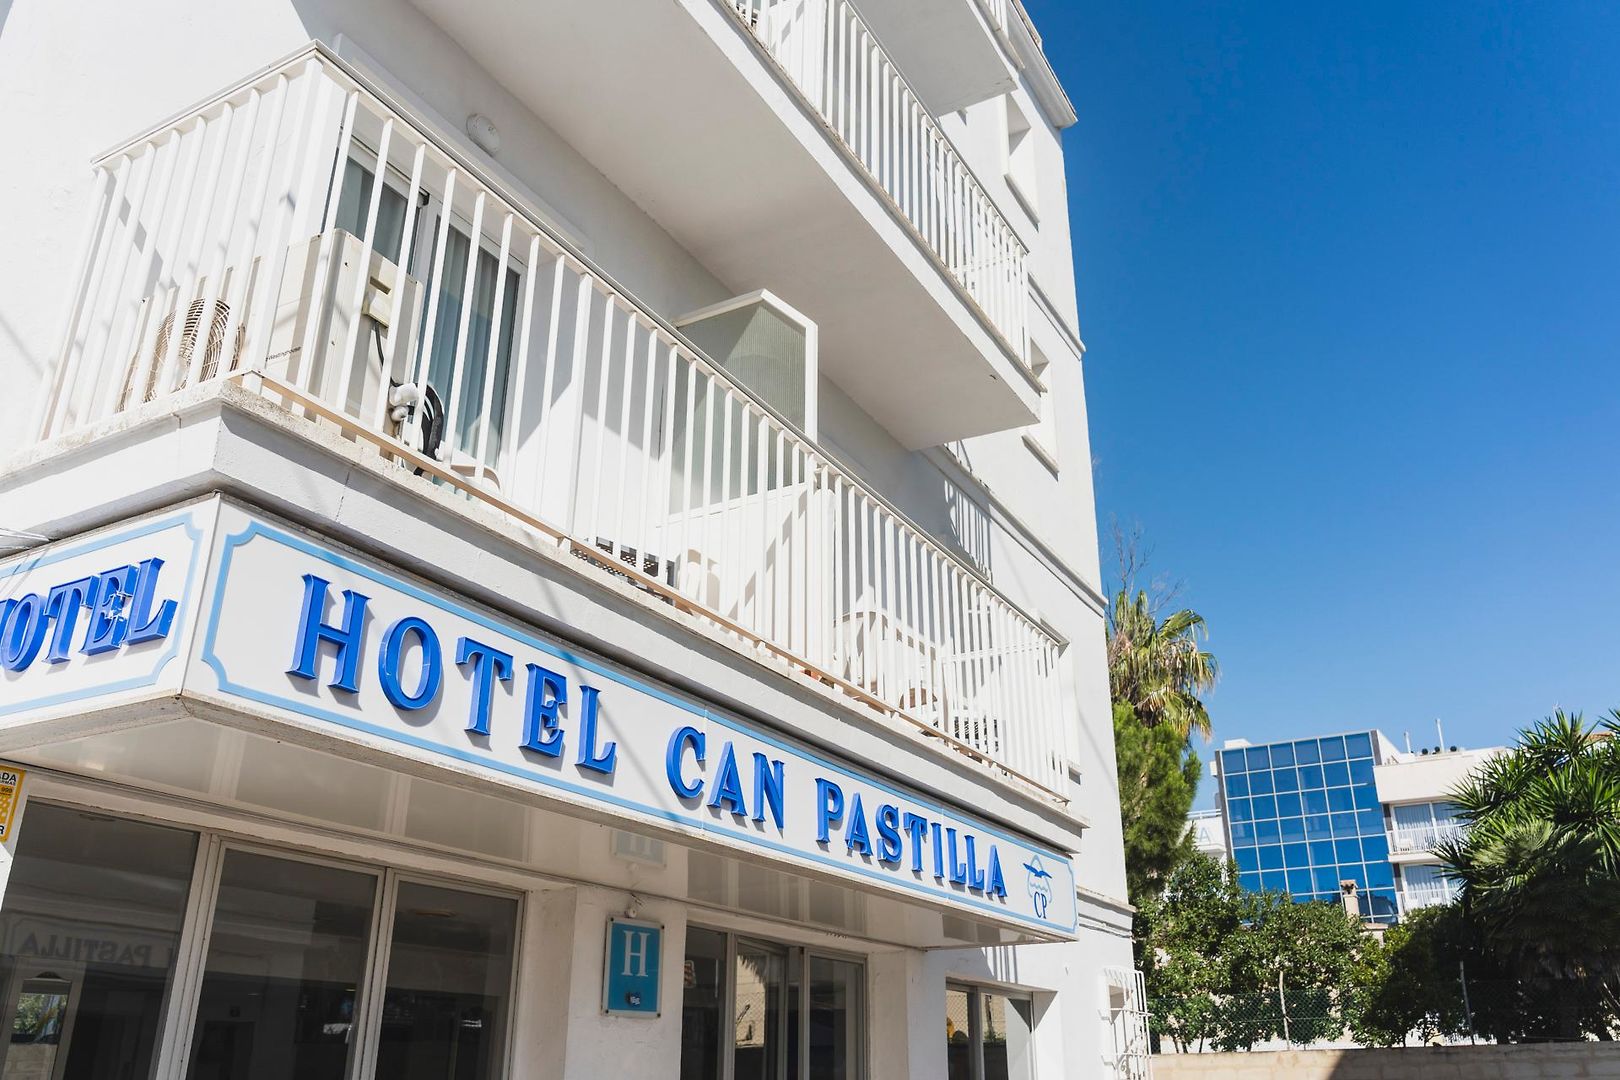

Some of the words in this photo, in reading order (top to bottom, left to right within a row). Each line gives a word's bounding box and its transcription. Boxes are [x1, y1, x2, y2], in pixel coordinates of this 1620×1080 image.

[0, 557, 178, 673] OTEL
[285, 573, 616, 774] HOTEL
[666, 726, 785, 830] CAN
[814, 777, 1008, 898] PASTILLA
[1034, 891, 1047, 919] CP
[621, 930, 651, 977] H
